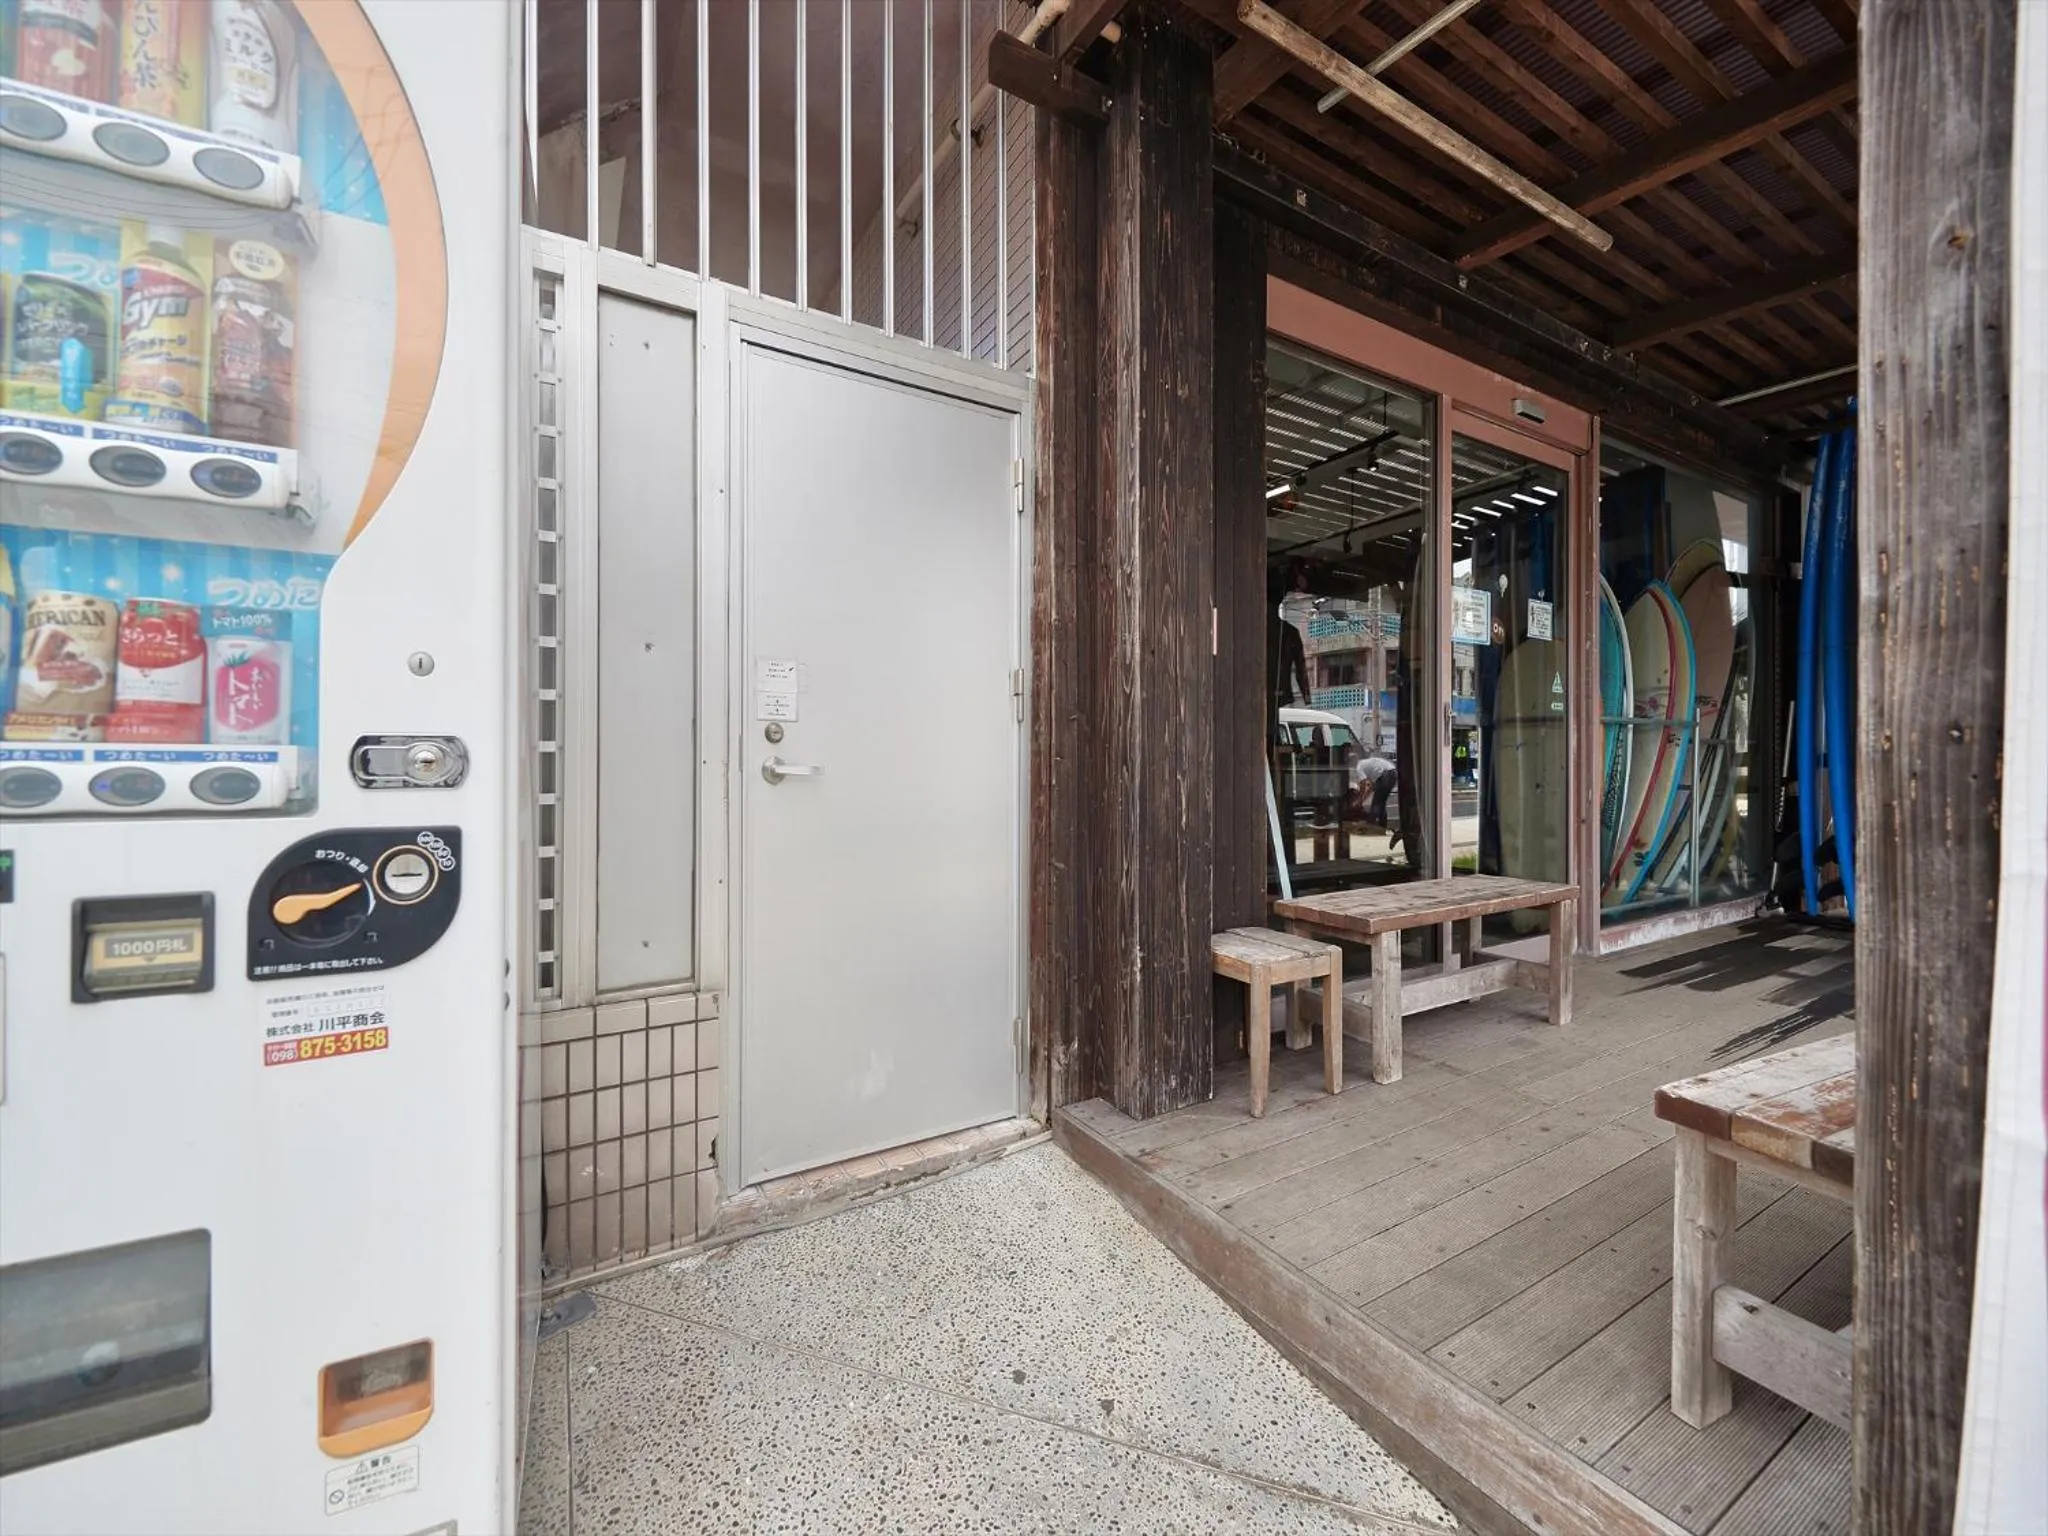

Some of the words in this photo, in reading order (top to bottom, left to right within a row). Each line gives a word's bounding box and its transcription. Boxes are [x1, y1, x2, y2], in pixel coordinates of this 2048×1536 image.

[111, 938, 188, 956] 1000円札
[266, 1023, 315, 1038] 株式会社
[318, 1011, 386, 1032] 川平商会
[300, 1029, 387, 1059] 875-3158
